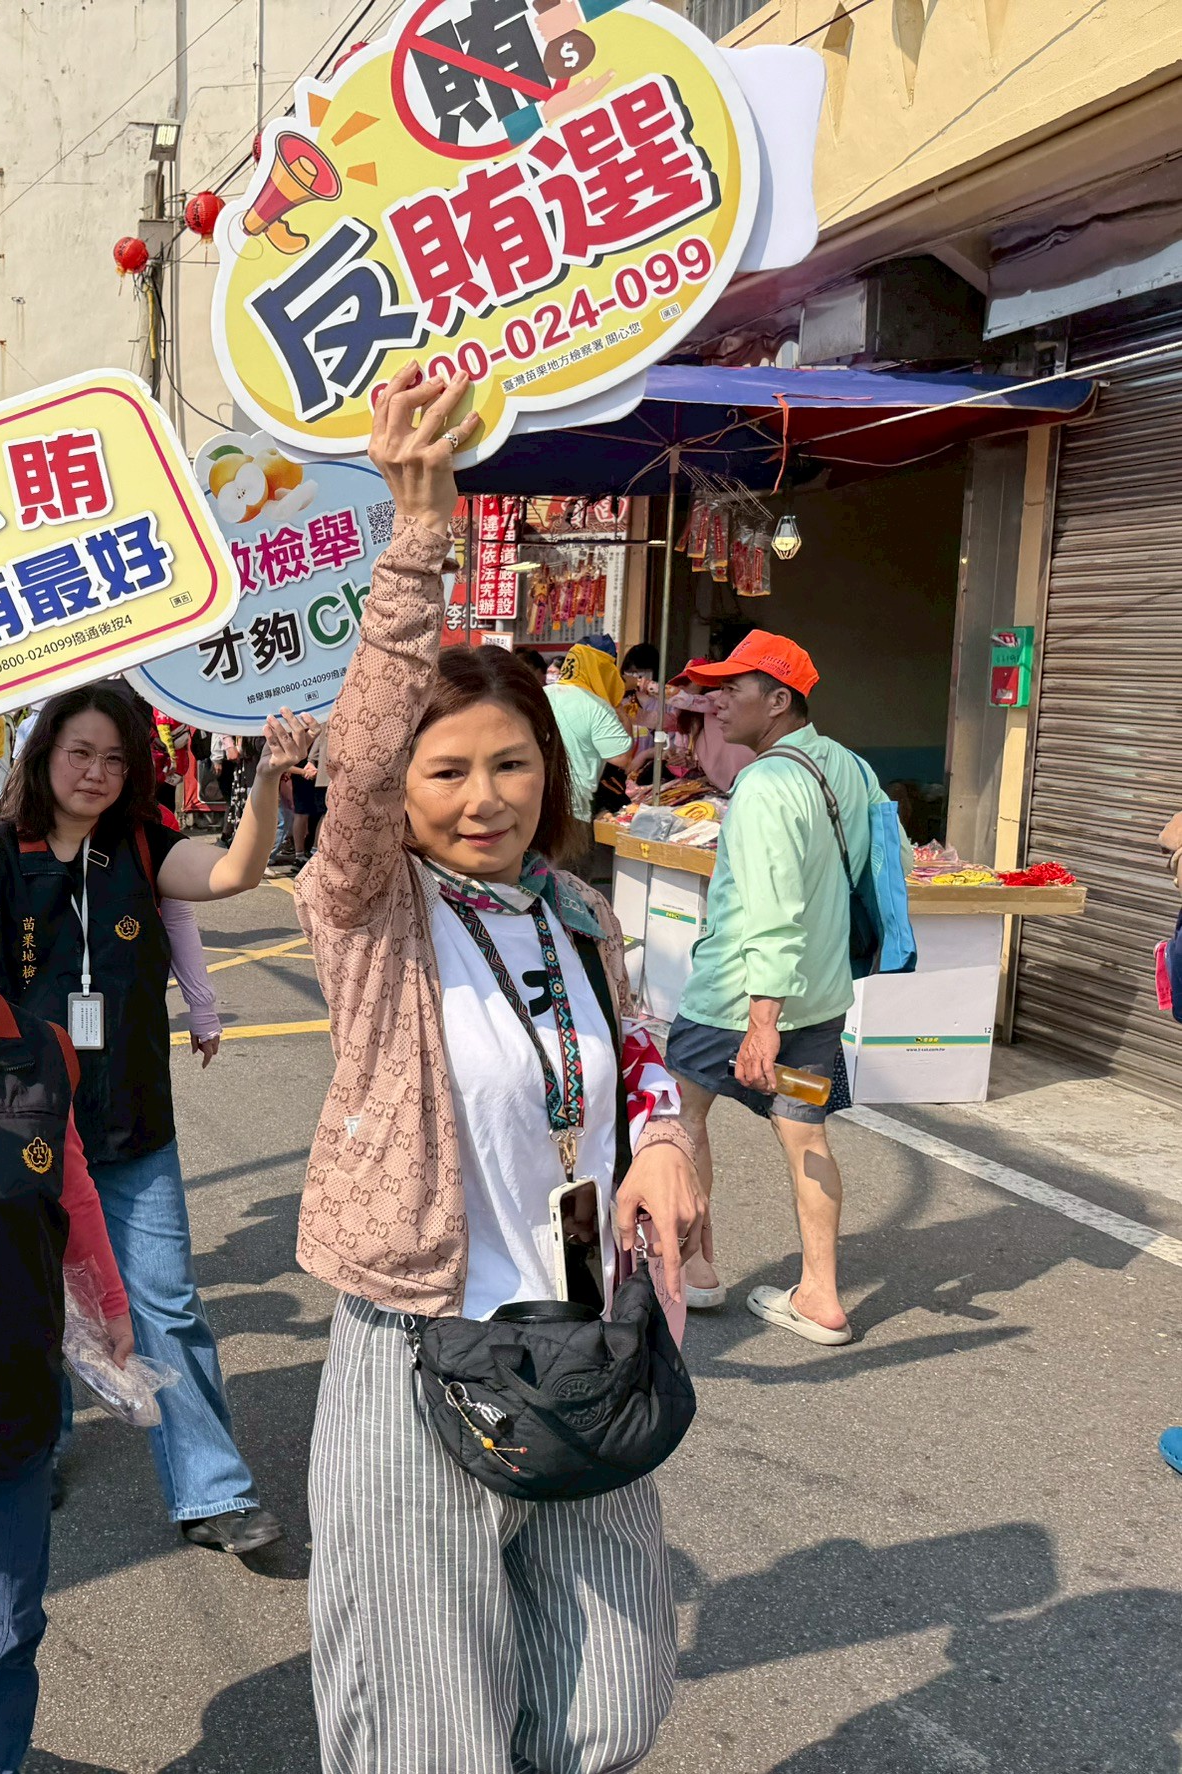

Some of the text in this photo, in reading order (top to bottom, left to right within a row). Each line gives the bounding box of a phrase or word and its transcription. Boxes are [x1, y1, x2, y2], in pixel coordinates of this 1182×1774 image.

[251, 82, 703, 413] 反賄選
[371, 237, 711, 409] 00-024-099
[503, 322, 641, 391] 臺灣苗栗地方檢察署 關心您
[8, 434, 108, 525] 賄
[199, 612, 302, 680] 才夠
